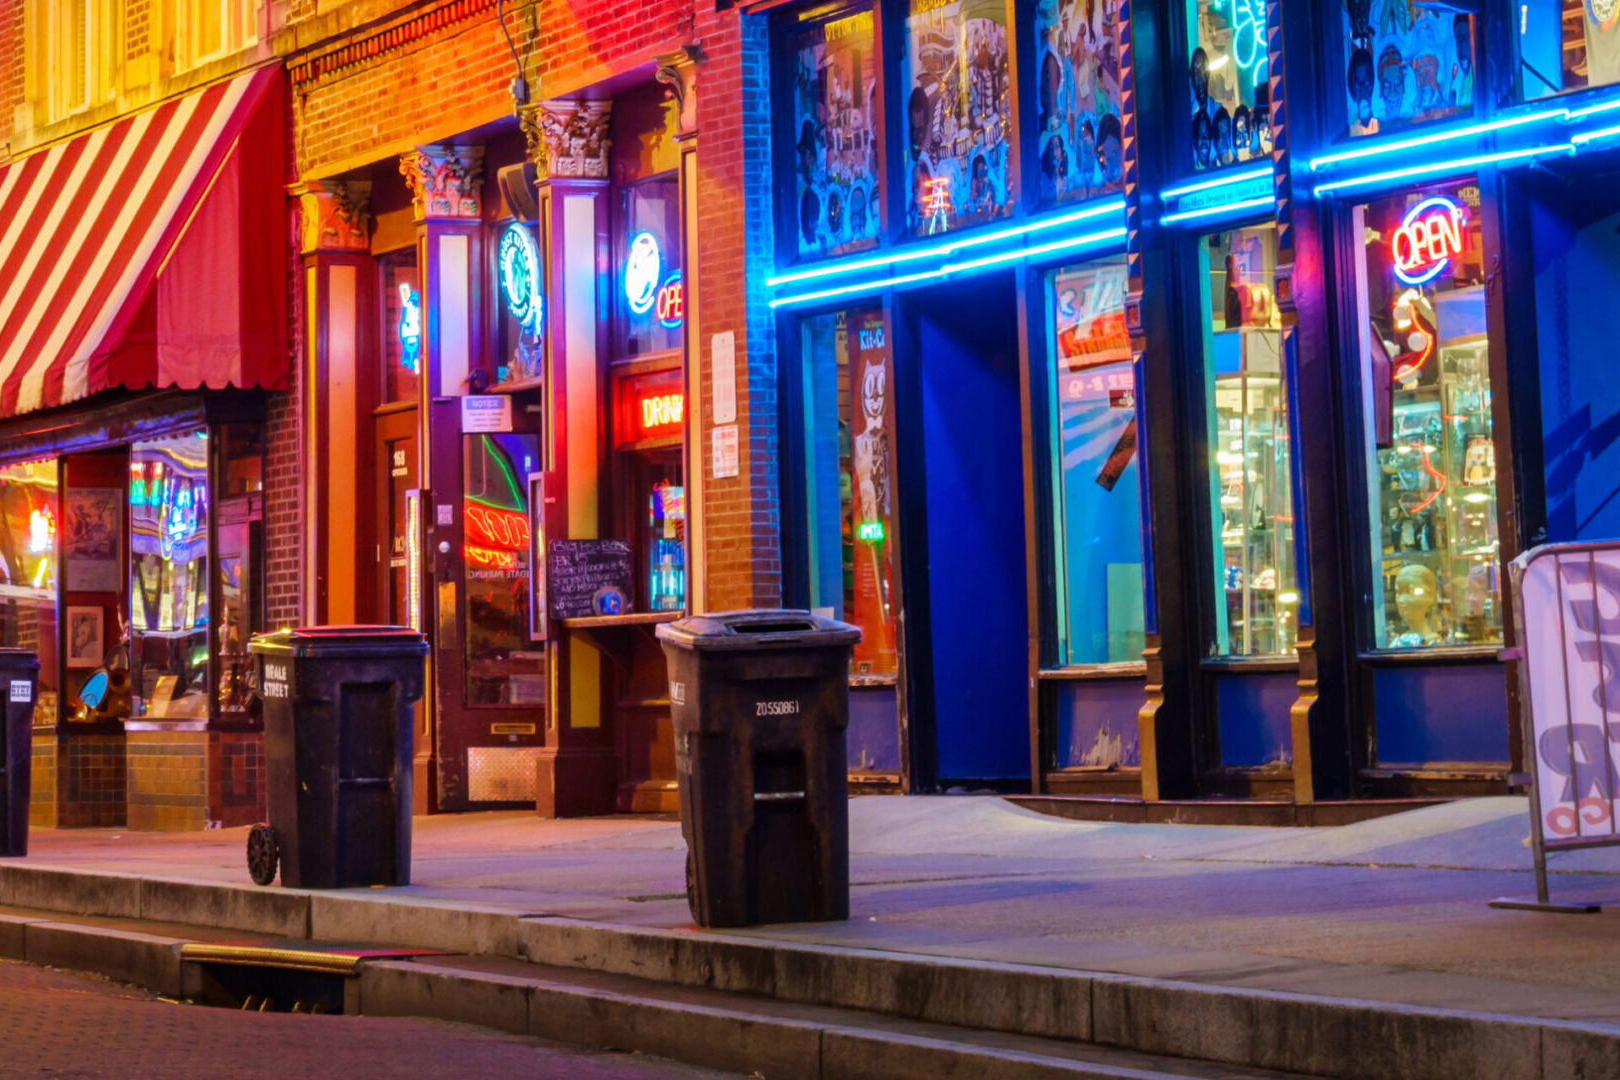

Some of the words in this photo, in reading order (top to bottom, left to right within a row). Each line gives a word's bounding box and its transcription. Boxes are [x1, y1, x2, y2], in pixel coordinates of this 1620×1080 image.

[1392, 208, 1461, 271] OPEN
[471, 398, 500, 408] NOTICE
[264, 663, 287, 681] BEALE
[263, 680, 289, 699] STREET
